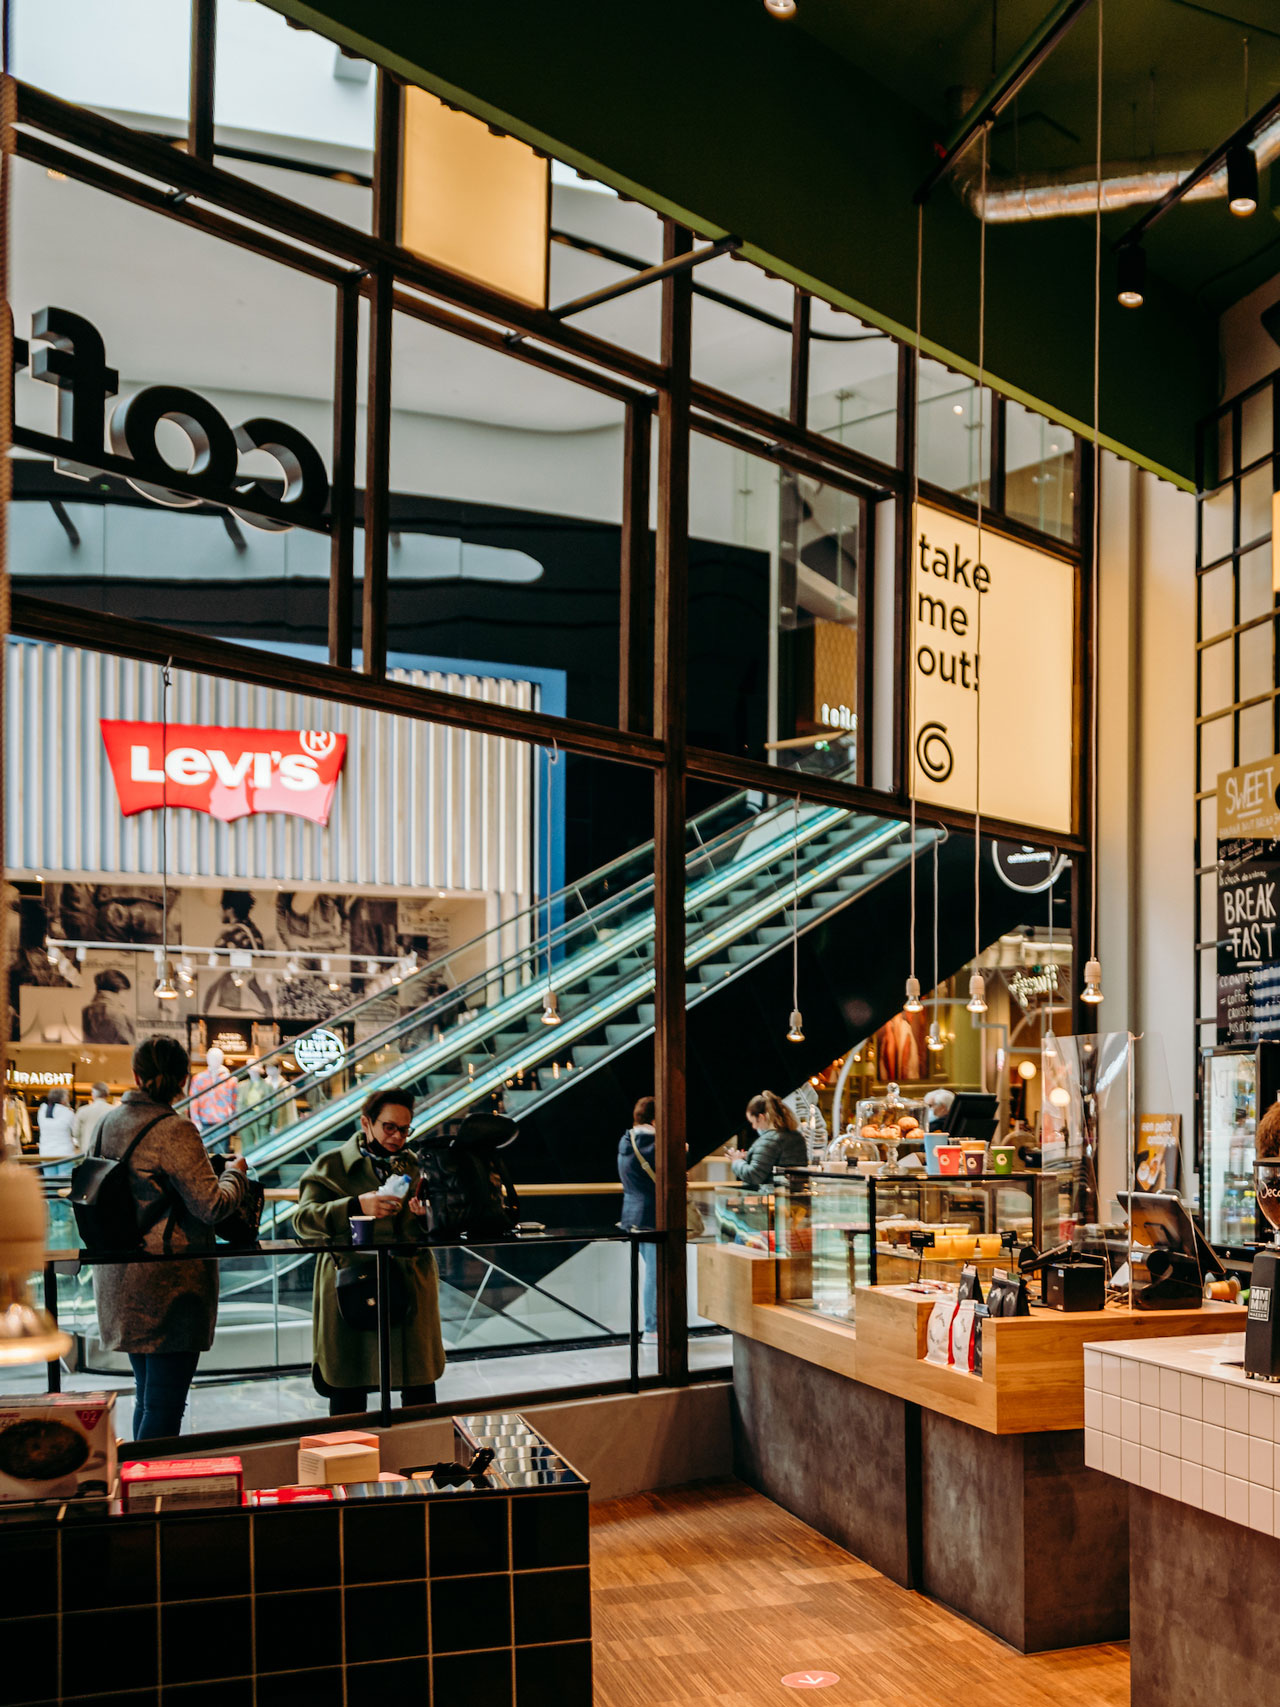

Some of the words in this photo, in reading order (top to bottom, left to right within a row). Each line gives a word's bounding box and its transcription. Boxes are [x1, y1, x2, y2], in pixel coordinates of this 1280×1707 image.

[918, 533, 992, 594] take
[918, 592, 968, 637] me
[917, 645, 979, 693] out!
[1225, 766, 1275, 816] SWEET
[1224, 882, 1276, 926] BREAK
